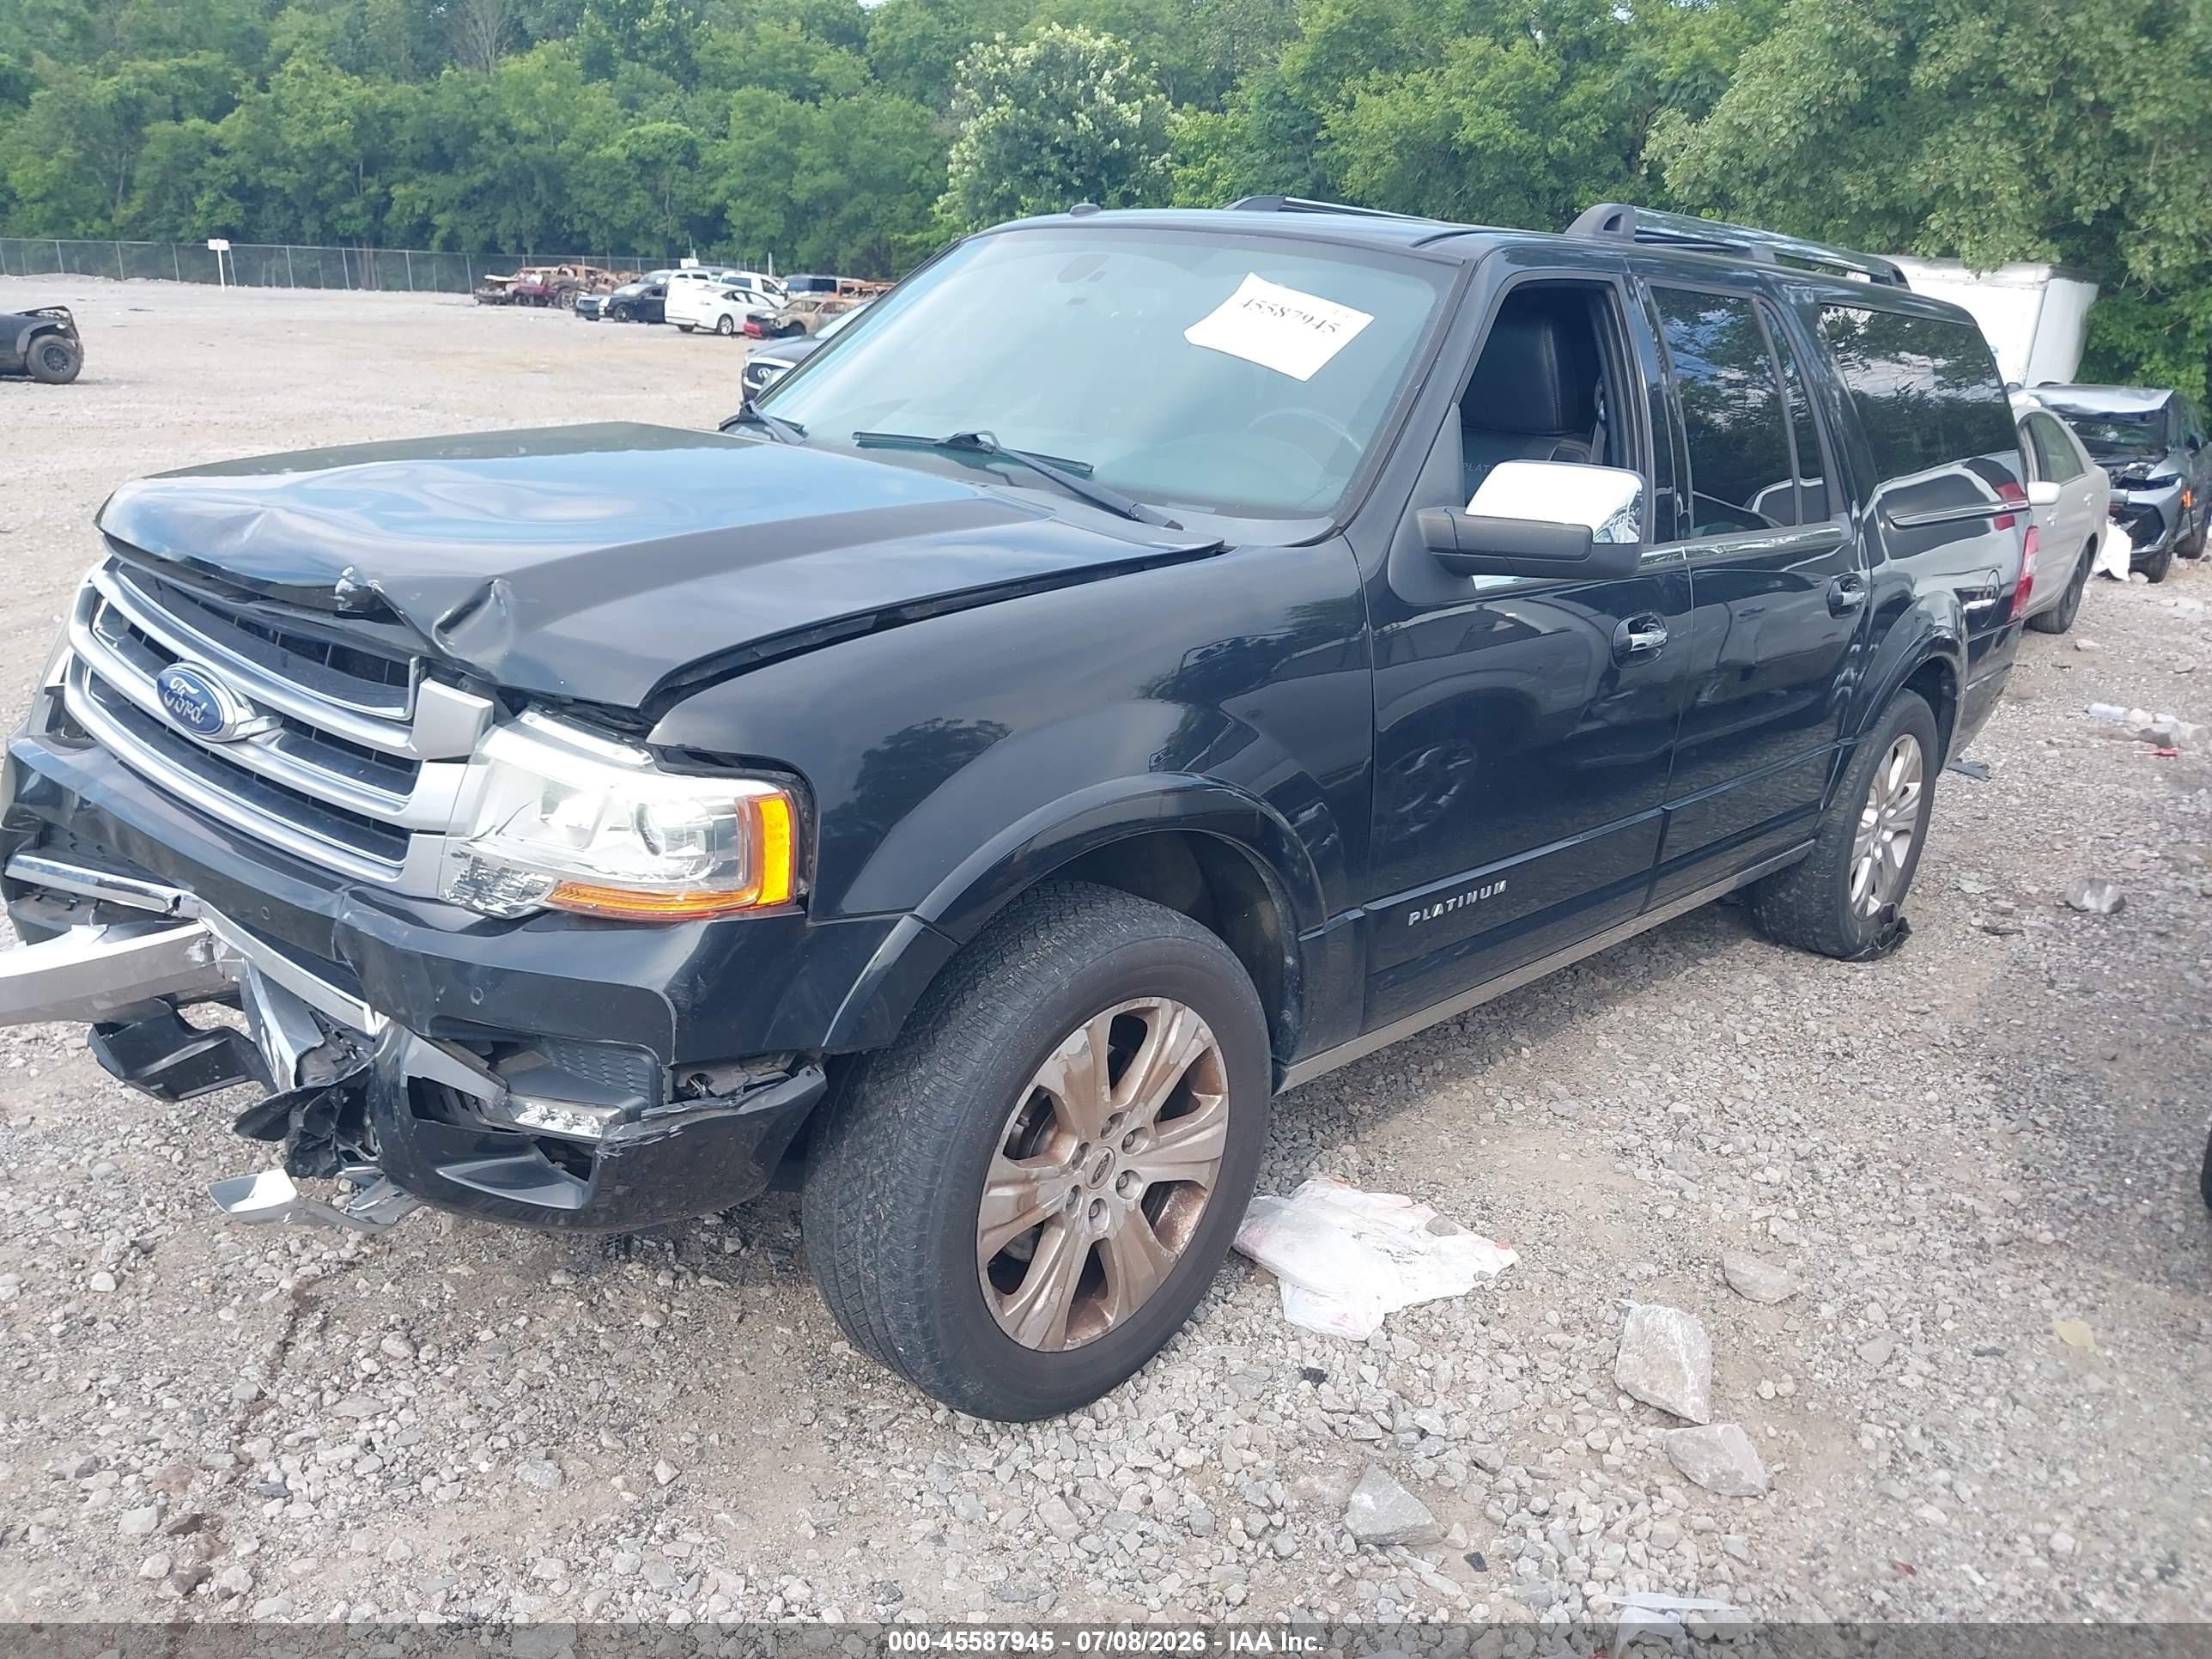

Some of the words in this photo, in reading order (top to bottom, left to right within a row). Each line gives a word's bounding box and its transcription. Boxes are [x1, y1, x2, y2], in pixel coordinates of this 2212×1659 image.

[1241, 297, 1341, 335] 45587945
[1463, 462, 1494, 472] PLAT
[163, 677, 208, 725] Ford
[1407, 879, 1508, 927] PLATINUM
